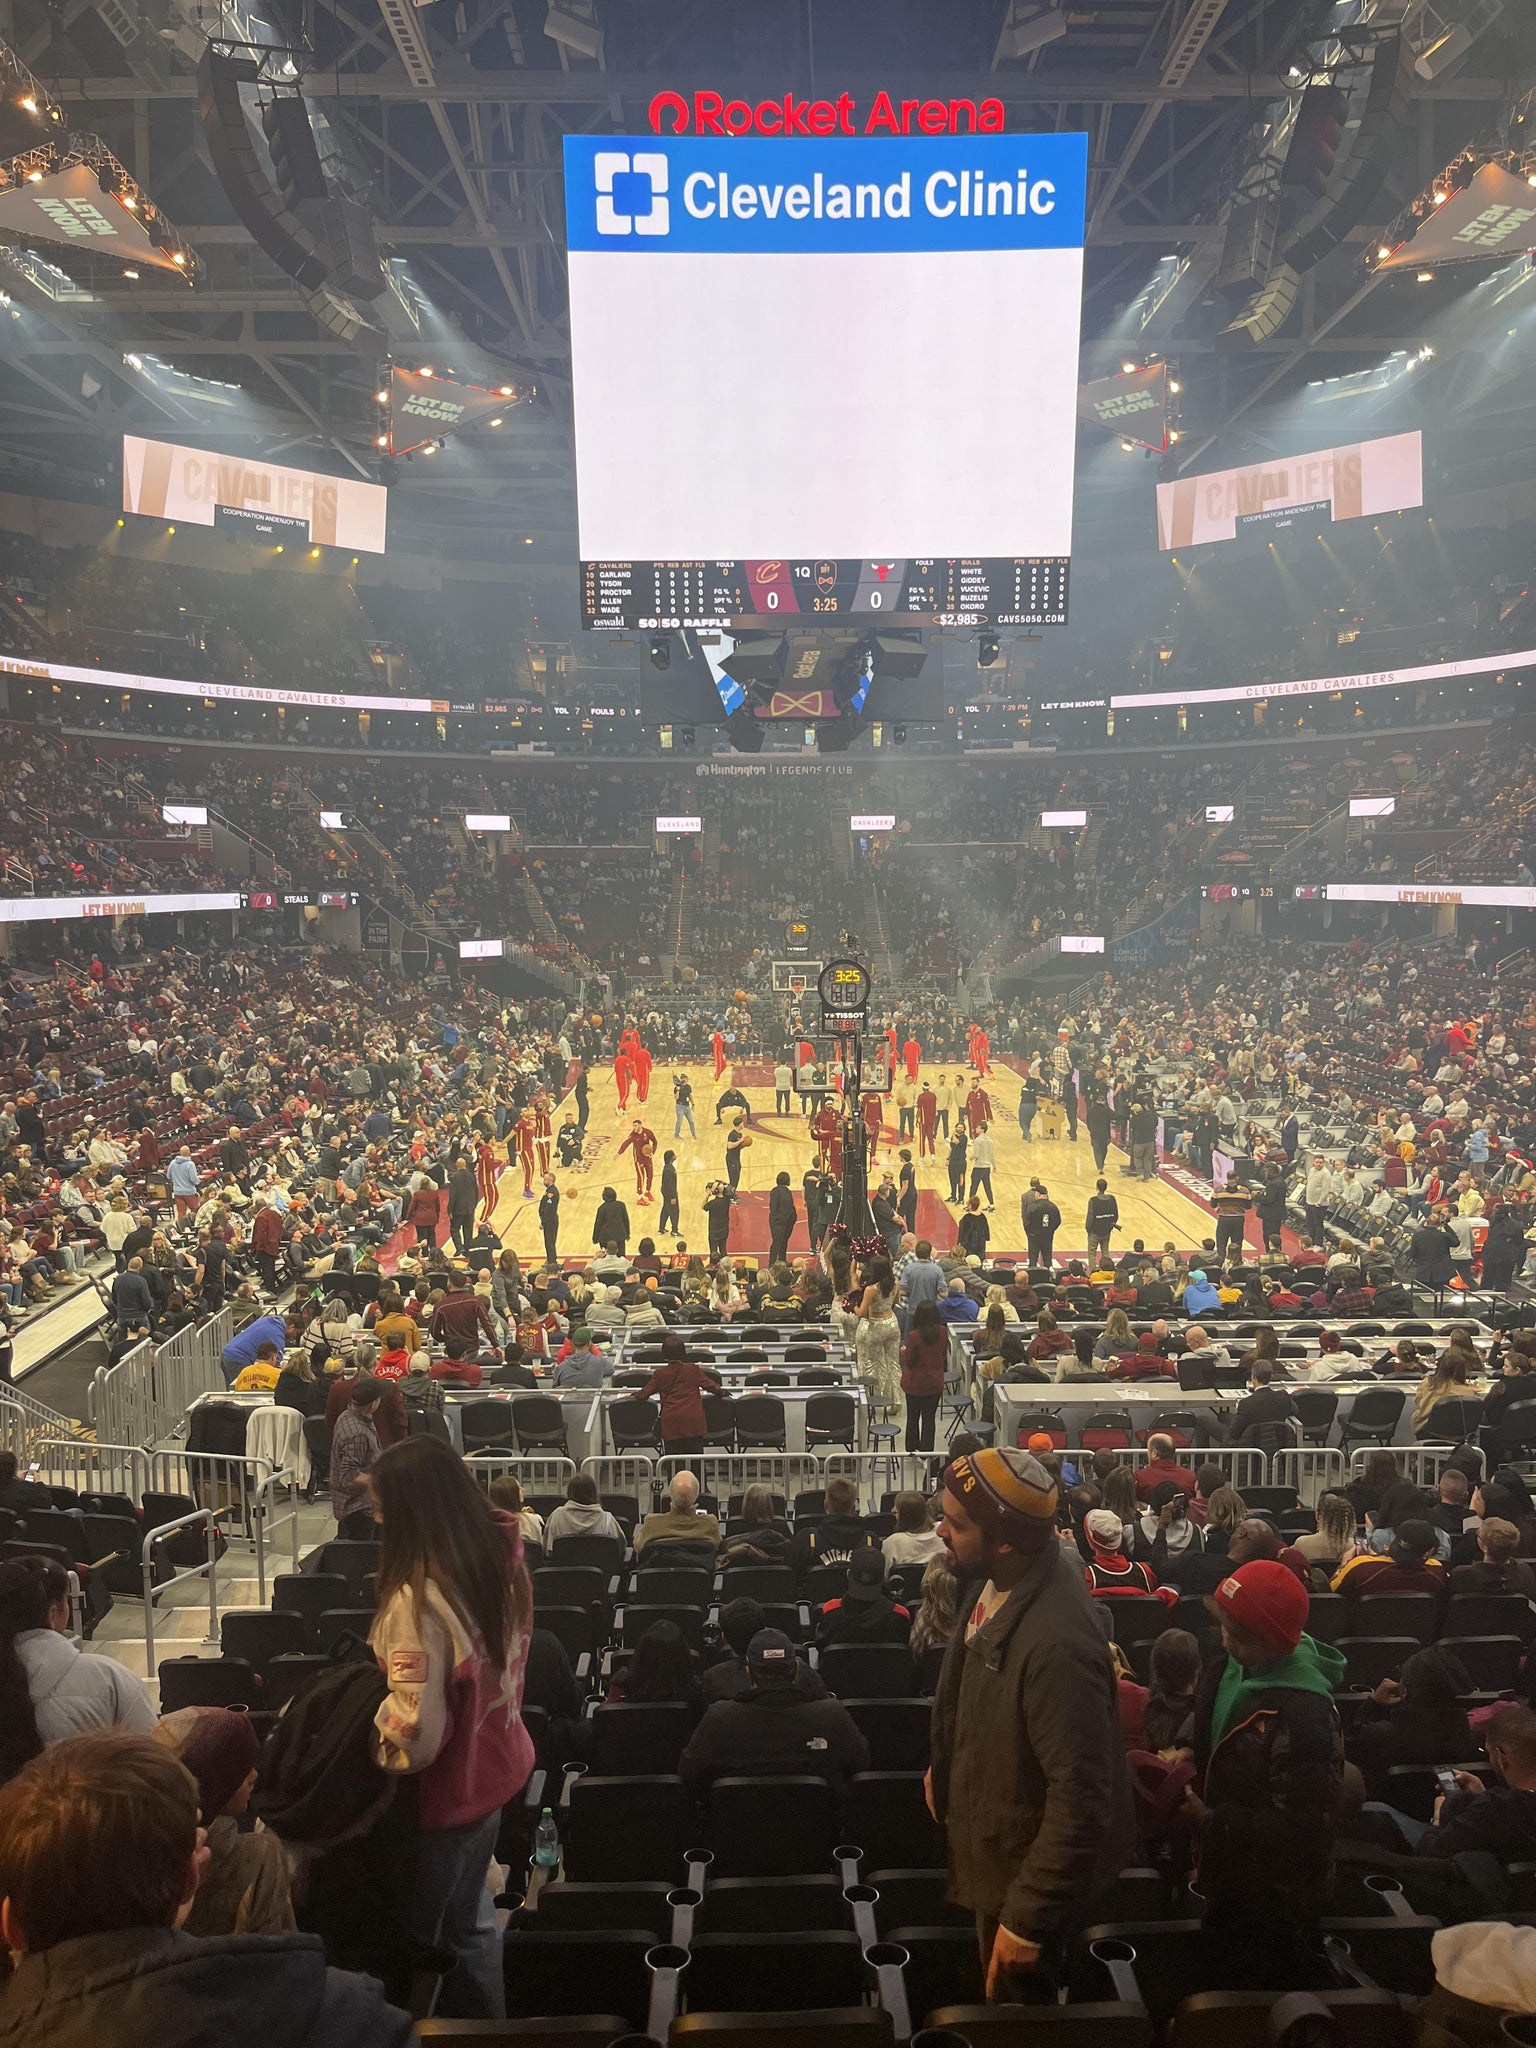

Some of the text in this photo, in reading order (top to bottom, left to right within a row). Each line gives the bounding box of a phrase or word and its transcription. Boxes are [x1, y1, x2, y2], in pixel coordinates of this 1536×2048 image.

[694, 91, 1005, 136] Rocket Arena
[683, 169, 1056, 219] Cleveland Clinic
[64, 197, 104, 219] LET
[1452, 203, 1512, 242] LET EM
[407, 394, 465, 413] LET EM
[1092, 389, 1151, 410] LET EM
[401, 403, 460, 423] KNOW.
[1098, 398, 1160, 420] KNOW.
[183, 457, 338, 525] CAVALIERS
[1205, 454, 1362, 522] CAVALIERS
[223, 507, 306, 528] COOPERATION ANDENJOY THE
[1243, 502, 1327, 523] COOPERATION ANDENJOY THE
[795, 567, 810, 577] 1Q
[767, 592, 882, 612] 0 3:25 0
[594, 616, 624, 627] oswald
[684, 619, 731, 627] RAFFLE
[940, 614, 978, 626] $2,985
[998, 615, 1065, 624] CAVS5050.COM
[1246, 673, 1395, 698] CLEVELAND CAVALIERS
[199, 684, 346, 706] CLEVELAND CAVALIERS
[554, 707, 580, 715] TOL 7
[590, 707, 615, 716] FOULS
[620, 708, 626, 716] 0
[948, 706, 954, 714] 0
[965, 705, 991, 713] TOL 7
[1040, 702, 1058, 710] LET
[1075, 700, 1107, 708] KNOW.
[710, 763, 853, 777] Huntington LEGENDS CLUB
[1231, 887, 1238, 897] 0
[1259, 887, 1274, 897] 3:25
[1295, 887, 1301, 897] 0
[1398, 890, 1415, 902] LET
[1416, 891, 1429, 903] EM
[266, 894, 328, 904] 0 STEALS 0
[82, 903, 101, 917] LET
[102, 903, 116, 916] EM
[368, 927, 388, 935] IN THE
[368, 936, 388, 944] PAINT
[1165, 937, 1190, 946] Power
[834, 970, 861, 982] 3:25
[1473, 1228, 1481, 1239] G
[377, 1366, 403, 1377] CARUSO
[819, 1548, 854, 1566] MITCHE
